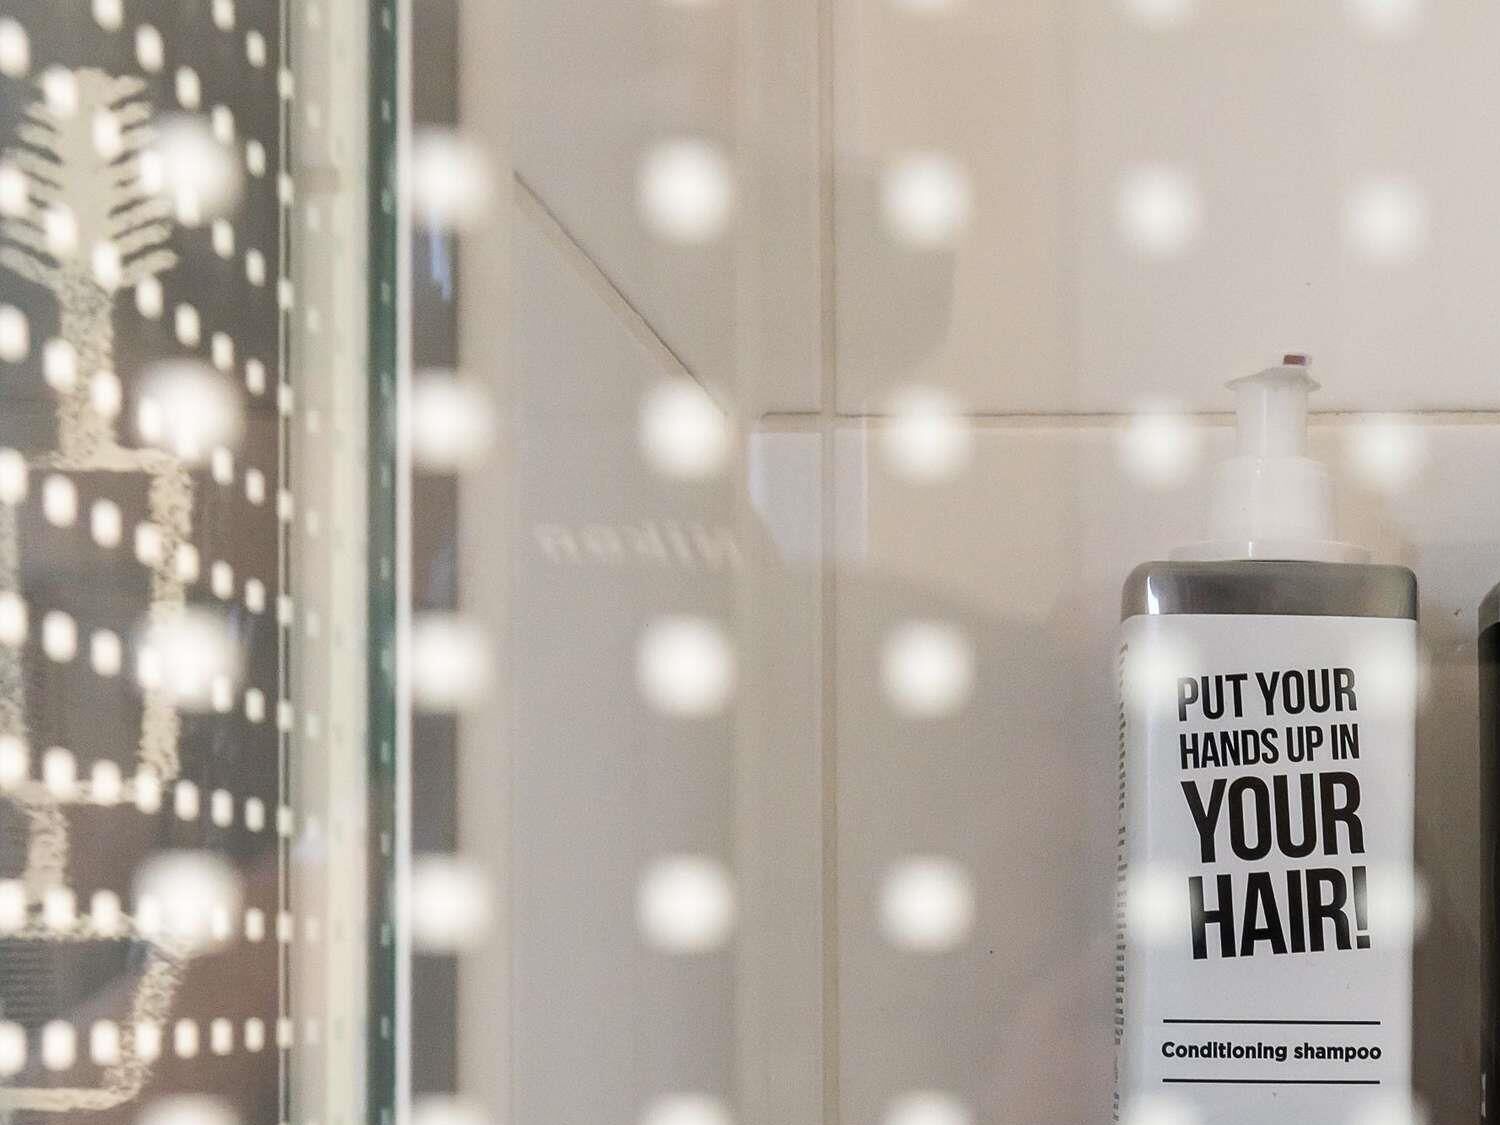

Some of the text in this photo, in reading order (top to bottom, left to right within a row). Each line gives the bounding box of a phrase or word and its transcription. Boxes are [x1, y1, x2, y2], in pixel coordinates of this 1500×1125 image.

[1177, 668, 1358, 722] PUT YOUR
[1179, 723, 1360, 769] HANDS UP IN
[1180, 771, 1366, 864] YOUR
[1188, 865, 1371, 960] HAIR!
[1161, 1041, 1382, 1062] Conditioning shampoo
